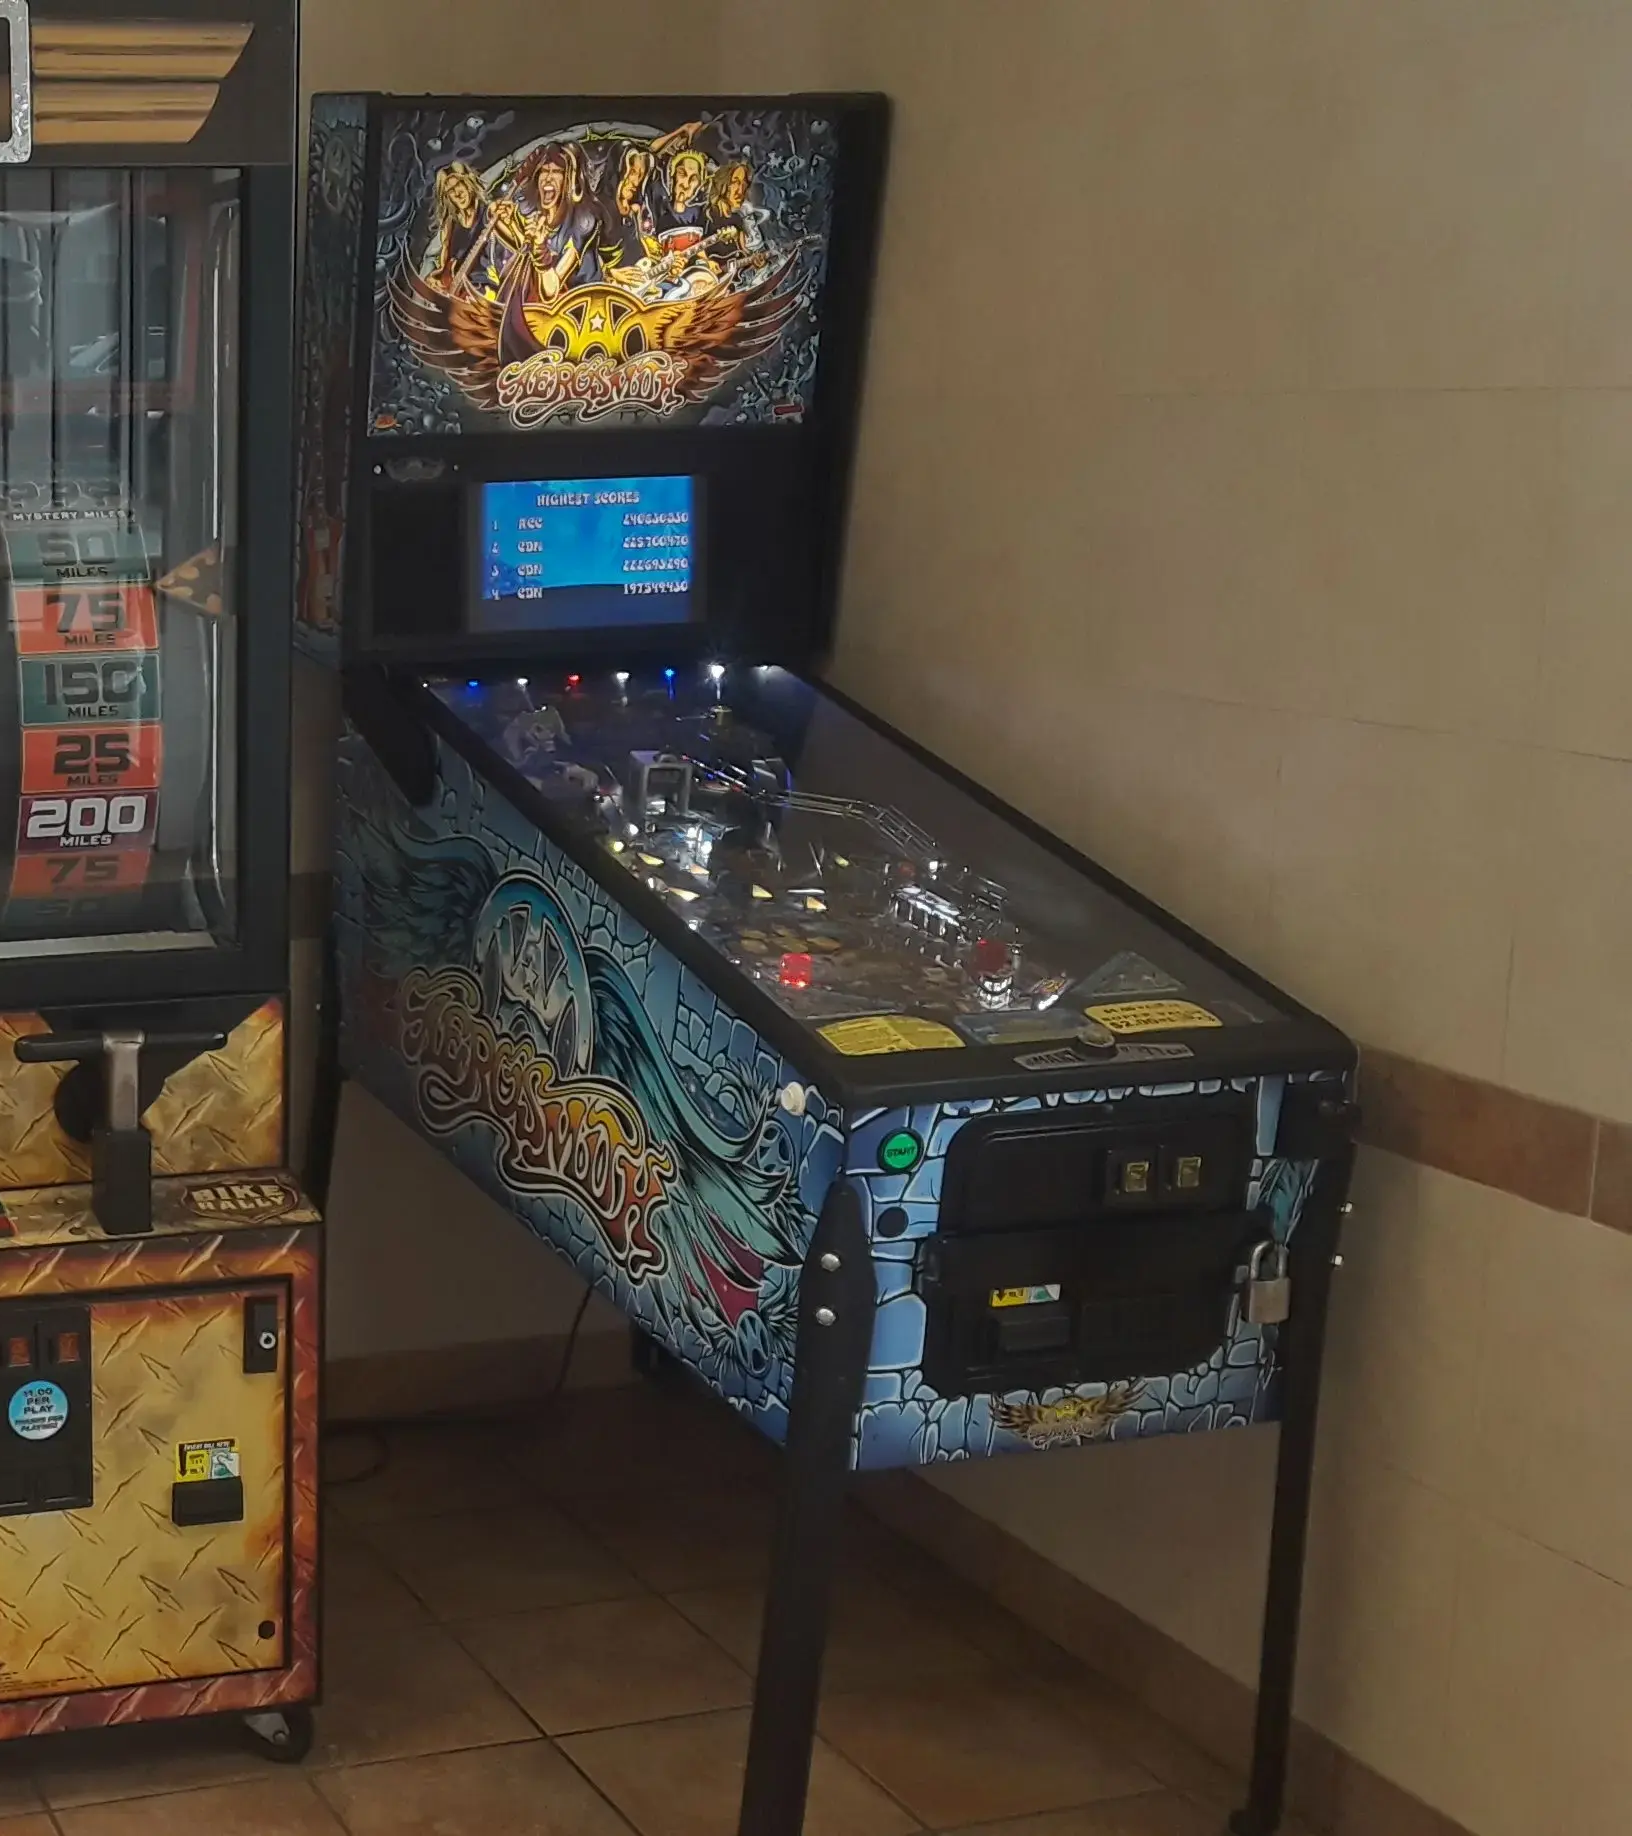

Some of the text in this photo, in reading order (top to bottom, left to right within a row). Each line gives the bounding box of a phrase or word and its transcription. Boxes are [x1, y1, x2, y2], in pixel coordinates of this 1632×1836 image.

[536, 491, 640, 507] HIGHEST SCORES
[12, 510, 126, 521] MYSTERY MILES
[38, 530, 116, 566] 50
[56, 566, 109, 577] MILES
[47, 593, 125, 633] 75
[64, 633, 116, 646] MILES
[44, 663, 138, 706] 150
[68, 705, 118, 718] MILES
[54, 734, 130, 774] 25
[65, 773, 118, 786] MILES
[26, 796, 147, 838] 200
[59, 834, 112, 847] MILES
[46, 857, 119, 885] 75
[191, 1184, 285, 1201] BIKE
[197, 1194, 285, 1210] RALLY
[26, 1396, 51, 1406] PER
[23, 1404, 55, 1415] PLAY
